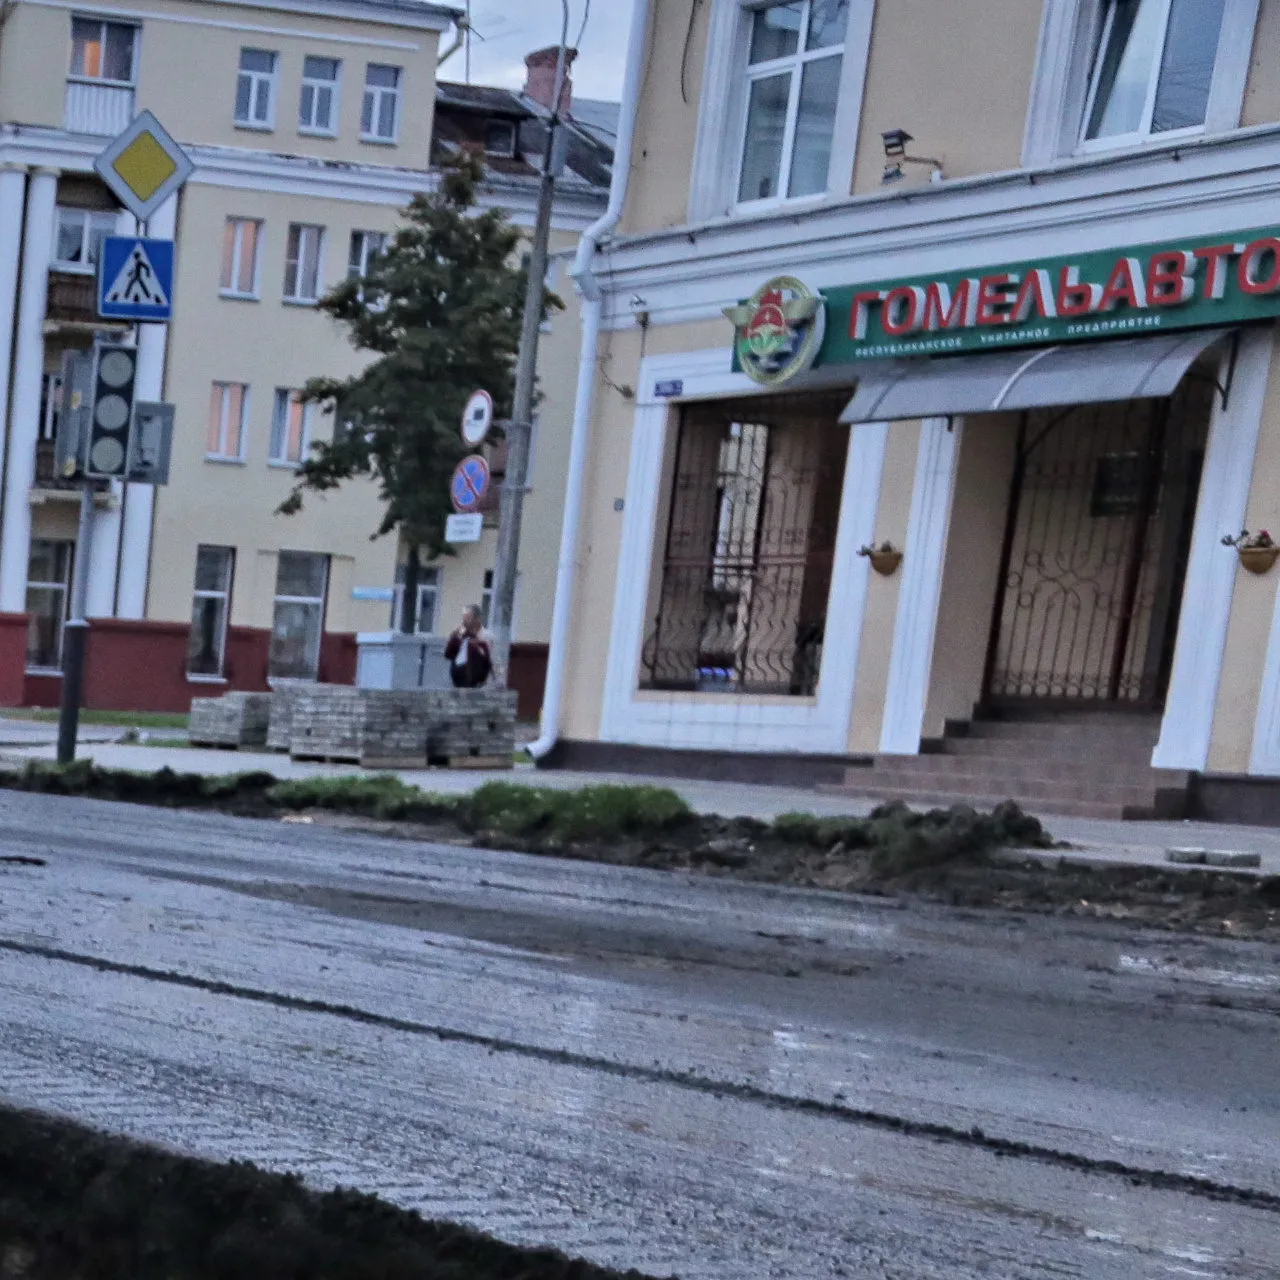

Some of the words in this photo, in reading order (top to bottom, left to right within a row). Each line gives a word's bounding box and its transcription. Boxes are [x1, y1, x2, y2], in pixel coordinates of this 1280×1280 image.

[854, 337, 963, 358] РЕСПУБЛИКАНСКОЕ
[980, 328, 1050, 344] УНИТАРНОЕ
[1067, 316, 1161, 334] ПРЕДПРИЯТИЕ
